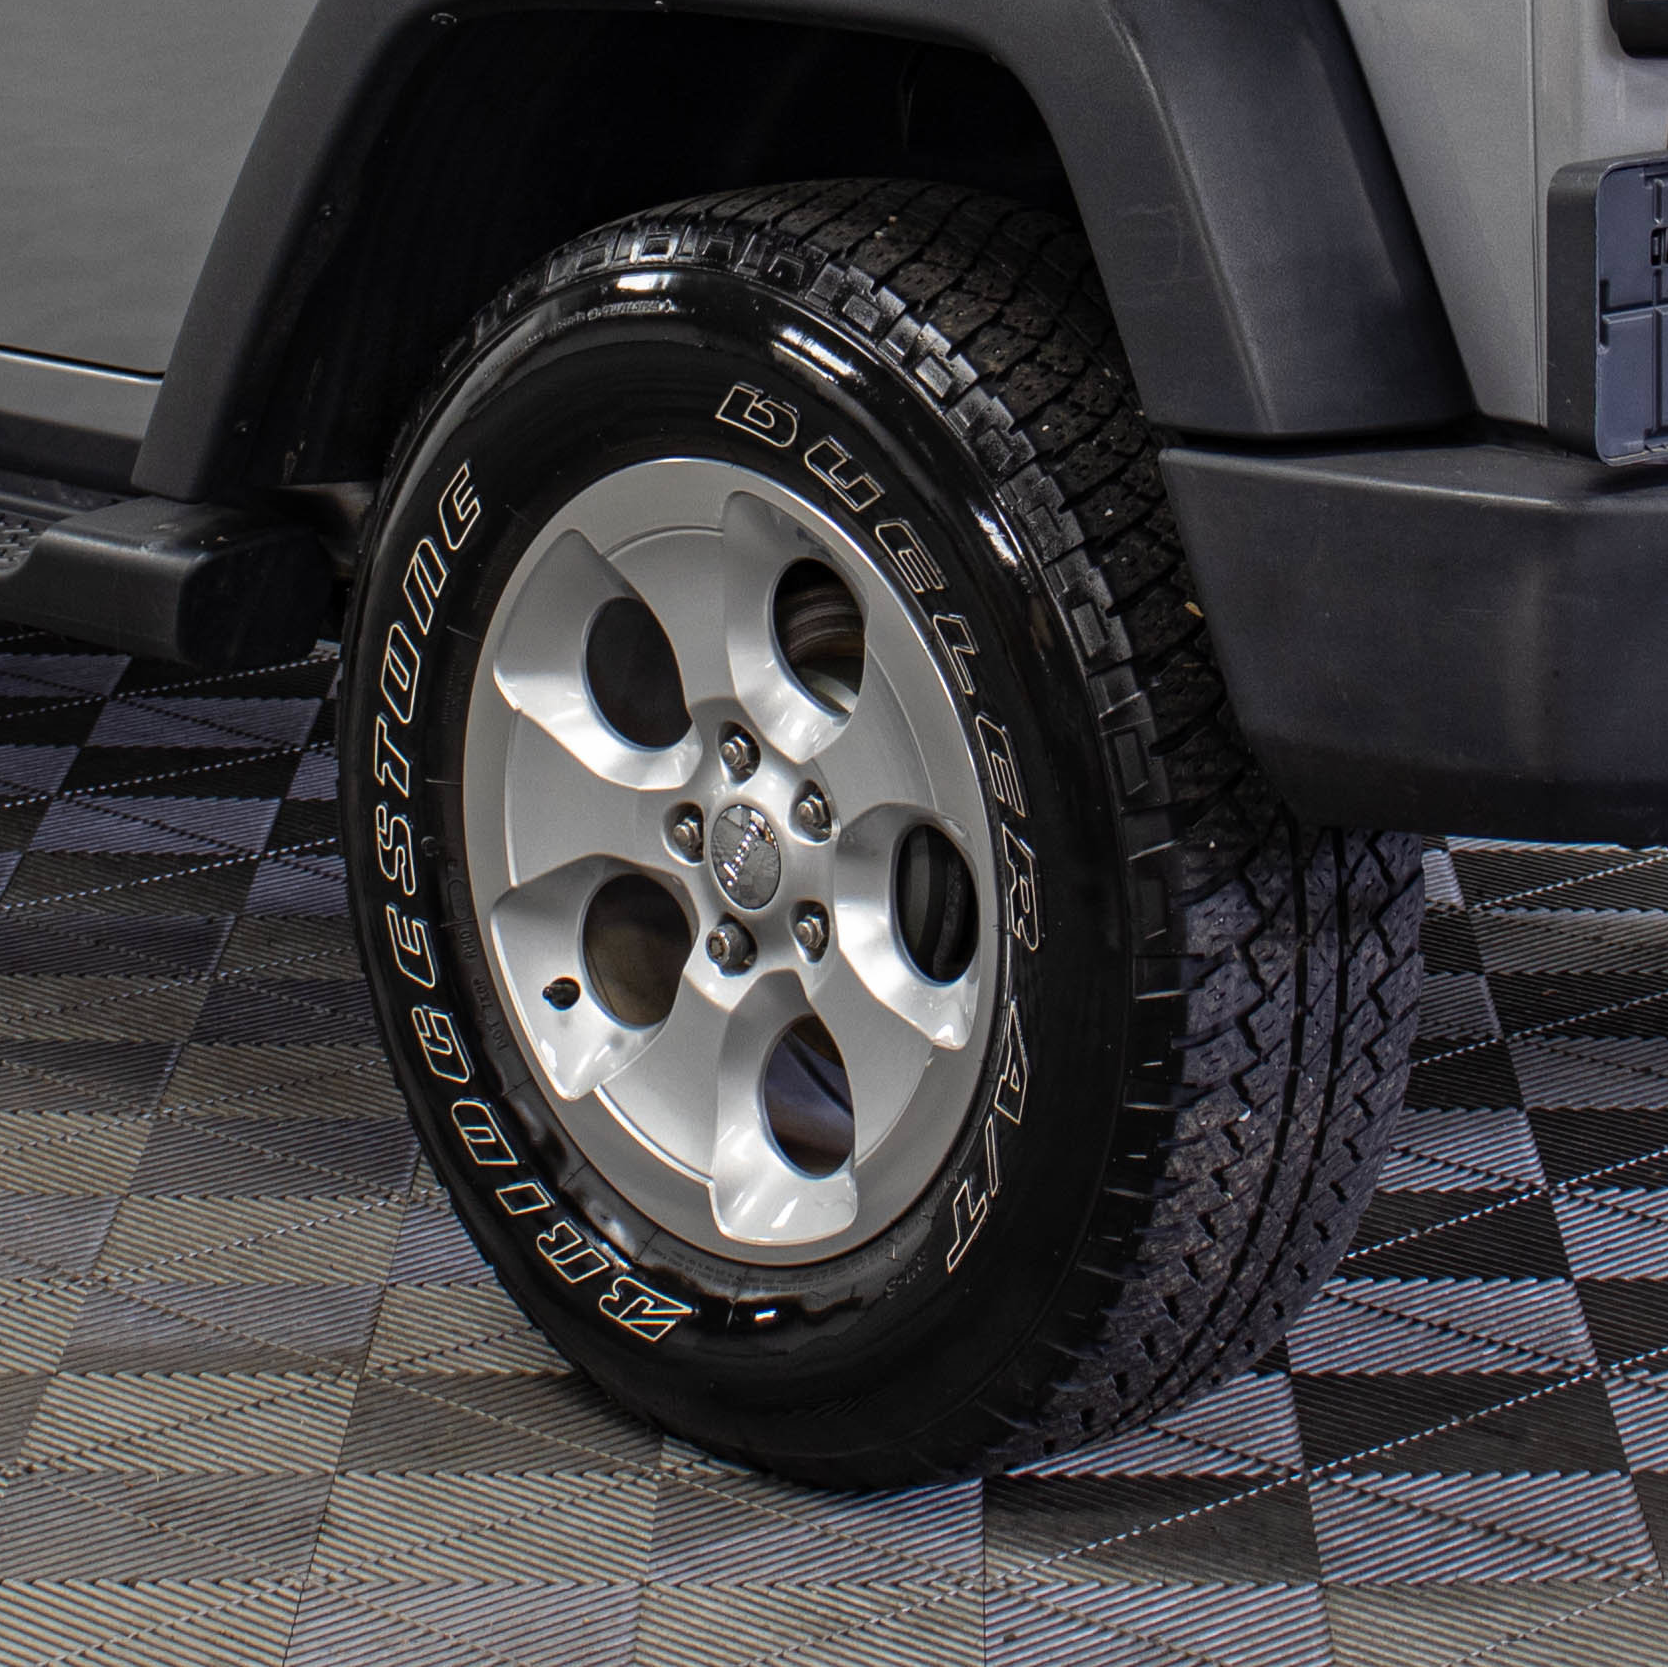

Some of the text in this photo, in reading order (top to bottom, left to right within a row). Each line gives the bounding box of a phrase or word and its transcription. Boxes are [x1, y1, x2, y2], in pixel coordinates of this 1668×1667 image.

[374, 460, 694, 1342] BRIDGESTONE
[715, 383, 1045, 1274] DUELER A/T
